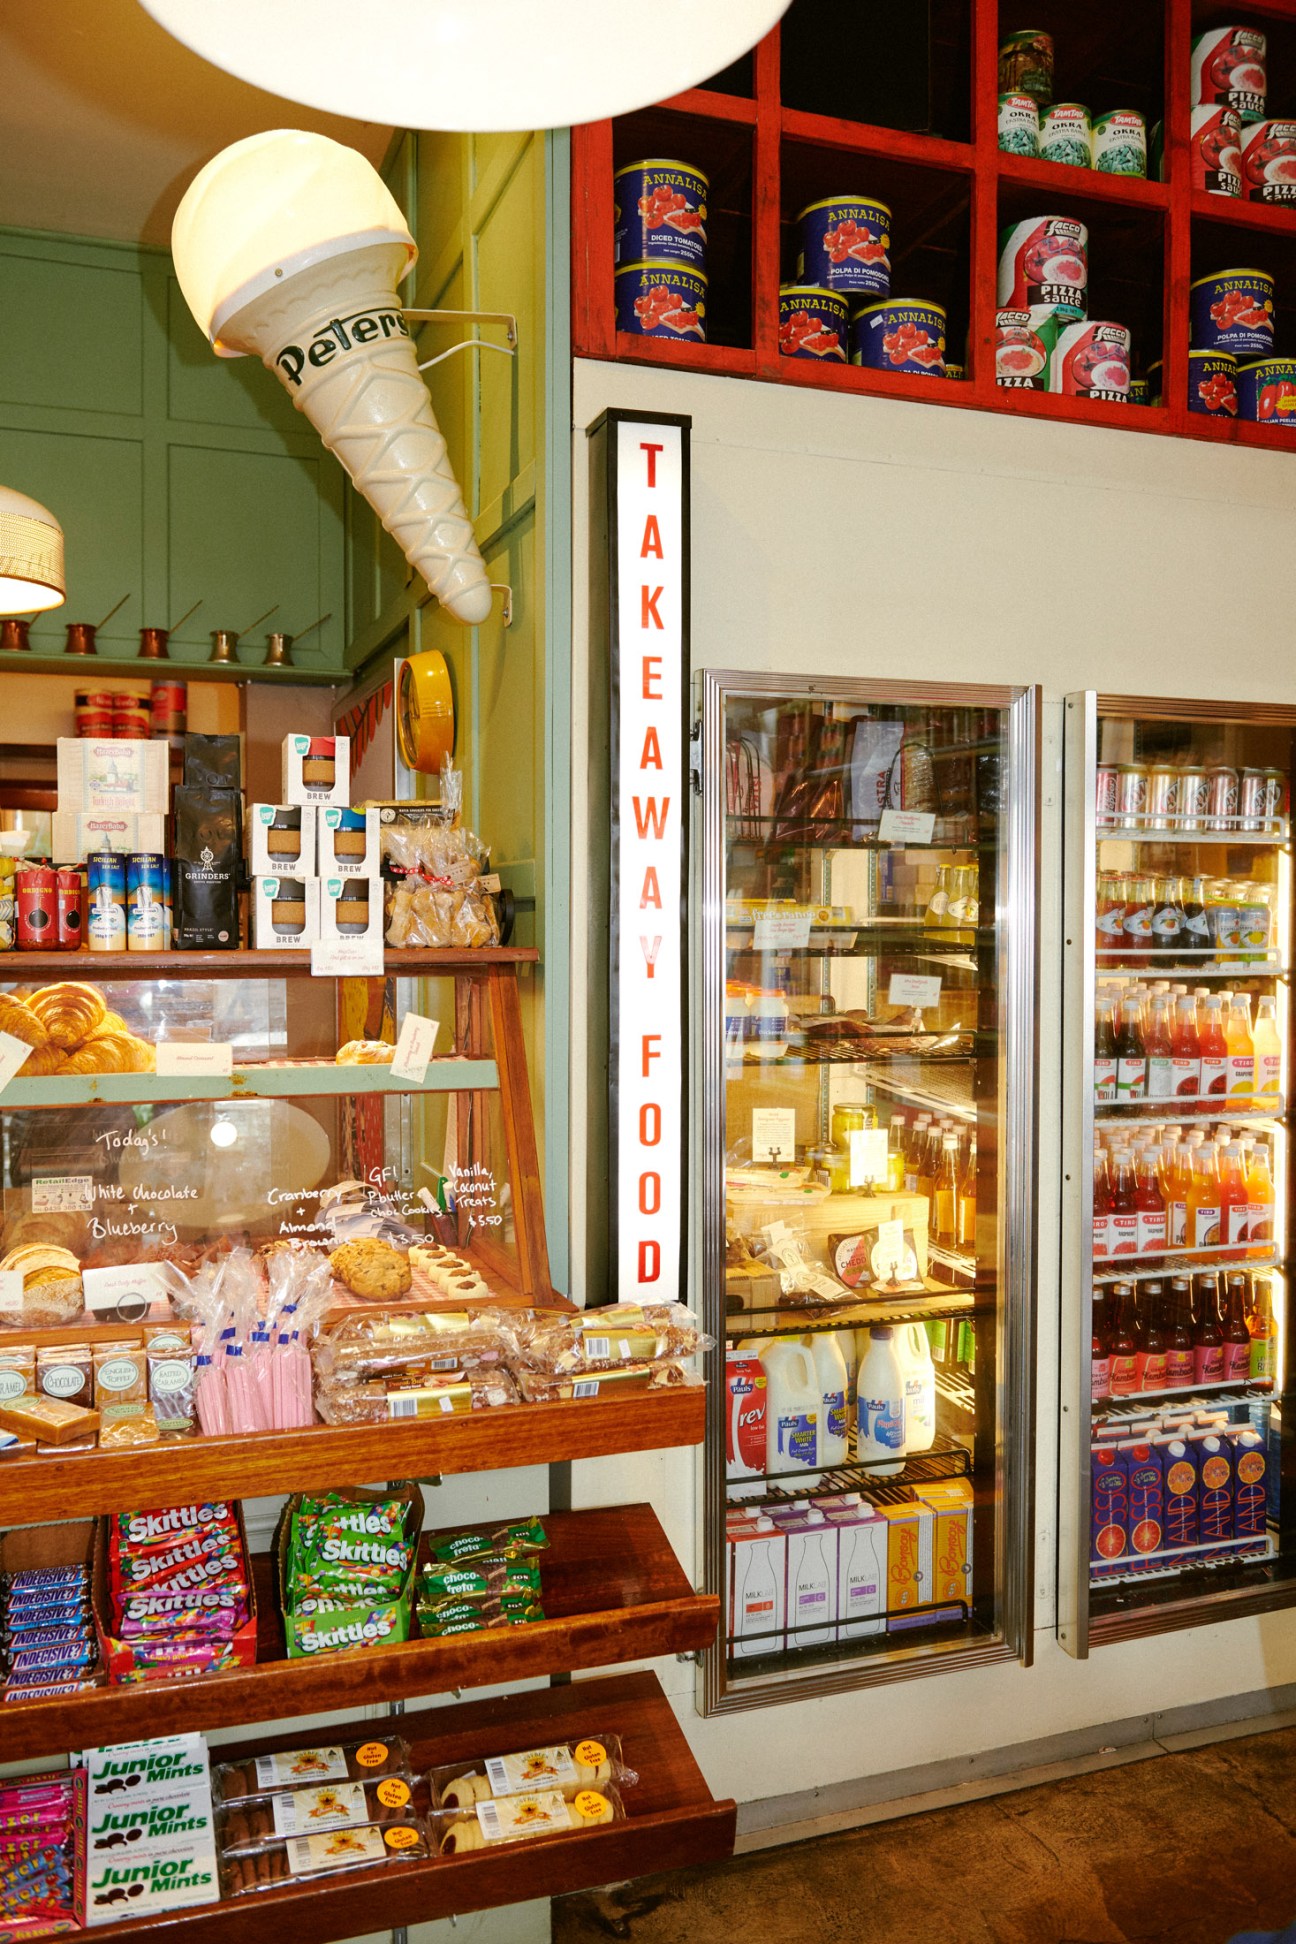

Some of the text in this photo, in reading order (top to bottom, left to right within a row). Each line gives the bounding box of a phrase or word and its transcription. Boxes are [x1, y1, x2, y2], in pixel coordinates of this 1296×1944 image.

[1052, 122, 1083, 130] OKRA
[1112, 129, 1142, 137] OKRA
[1266, 124, 1296, 140] SACC
[643, 173, 707, 201] ANNALISA
[1218, 173, 1242, 187] PIZZ
[1262, 185, 1296, 197] PIZZ
[828, 208, 891, 231] ANNALISA
[1046, 220, 1081, 236] SACCO
[831, 267, 852, 275] POLPA
[639, 273, 705, 298] ANNALISA
[1041, 285, 1082, 299] PIZZA
[1214, 280, 1273, 297] ANNALISA
[779, 298, 845, 320] ANNALISA
[1043, 294, 1081, 307] sauce
[276, 307, 409, 386] Peters
[1203, 362, 1237, 376] ANNAL
[997, 377, 1034, 388] IZZA
[306, 792, 331, 800] BREW
[271, 863, 296, 871] BREW
[631, 442, 671, 1284] TAKEAWAY FOOD
[96, 1129, 167, 1155] Today's!
[369, 1165, 398, 1187] GF!
[84, 1184, 125, 1202] White
[453, 1179, 497, 1193] Coconut
[267, 1187, 342, 1205] Cranberry
[455, 1195, 497, 1208] Treats
[128, 1203, 138, 1215] +
[87, 1217, 178, 1245] Blueberry
[279, 1216, 337, 1234] Almond
[840, 1256, 867, 1269] CHEDD
[0, 1382, 22, 1393] RAMEL
[733, 1384, 752, 1393] Pauls
[739, 1401, 766, 1428] rev
[128, 1502, 228, 1543] Skittles
[331, 1512, 392, 1534] ttles
[321, 1540, 408, 1571] Skittles
[14, 1571, 74, 1588] INDECISIVE?
[149, 1554, 238, 1593] kittles
[443, 1571, 480, 1585] choco-
[11, 1588, 74, 1608] INDECISIVE?
[126, 1594, 235, 1620] Skittles
[12, 1607, 74, 1624] INDECISIVE?
[13, 1627, 77, 1644] INDECISIVE?
[301, 1621, 392, 1652] Skittles
[16, 1644, 81, 1668] INDECISIVE?
[6, 1668, 74, 1686] INDECISIVE?
[92, 1752, 187, 1780] Junior
[146, 1763, 204, 1783] Mints
[92, 1803, 190, 1834] Junior
[148, 1816, 207, 1838] Mints
[91, 1859, 193, 1889] Junior
[150, 1872, 212, 1893] Mints
